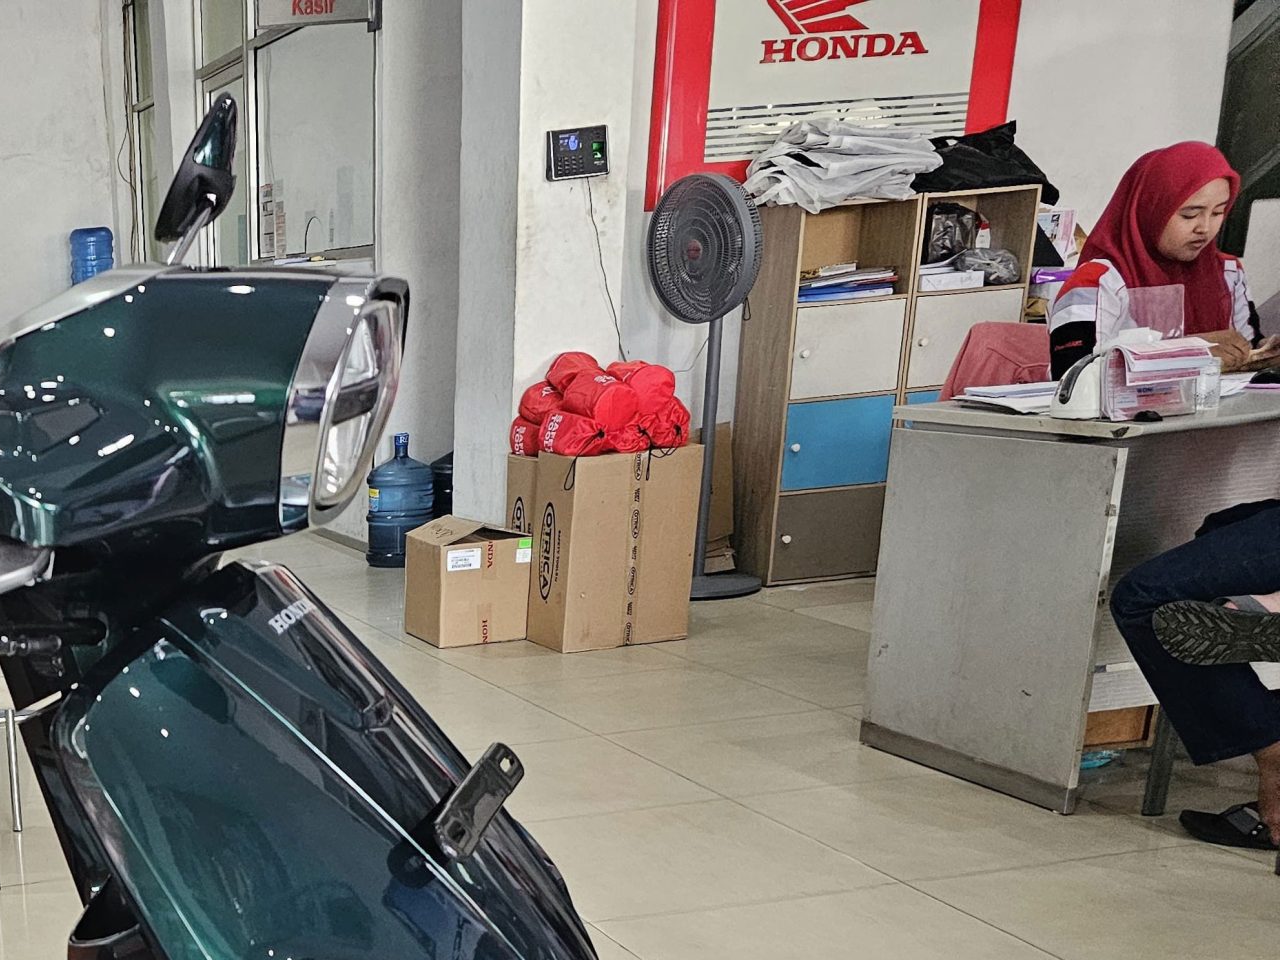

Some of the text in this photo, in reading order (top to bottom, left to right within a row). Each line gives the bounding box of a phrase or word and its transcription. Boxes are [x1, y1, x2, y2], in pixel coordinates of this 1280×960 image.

[759, 31, 929, 64] HONDA
[547, 415, 563, 452] SAFET
[541, 512, 553, 590] OTRICA
